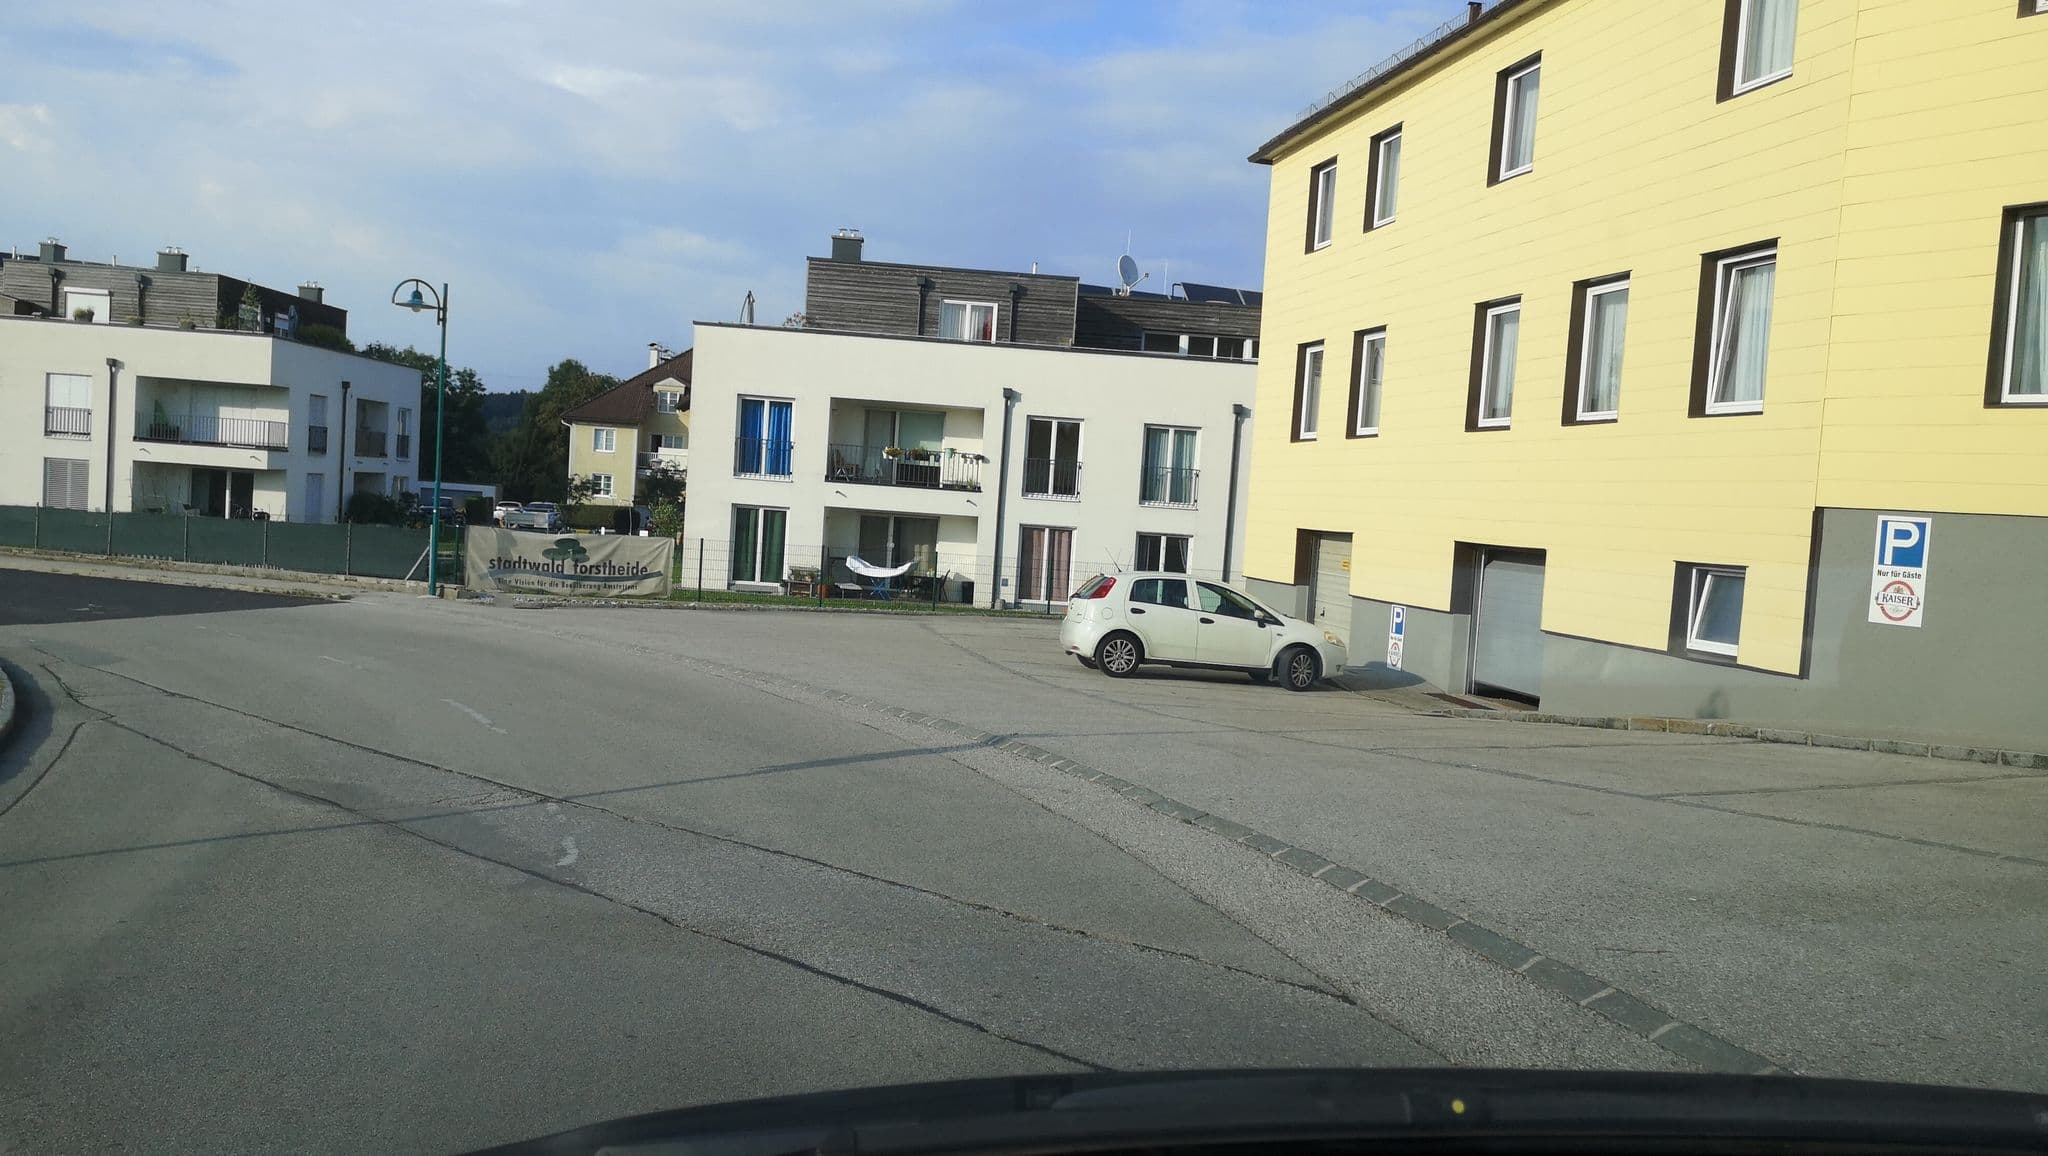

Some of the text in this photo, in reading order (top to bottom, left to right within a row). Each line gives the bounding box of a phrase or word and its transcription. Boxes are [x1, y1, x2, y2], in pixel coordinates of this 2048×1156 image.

[1884, 521, 1920, 565] P
[489, 556, 648, 576] stadtwald forstheide
[1877, 569, 1922, 580] Nur für Gäste
[514, 578, 535, 586] Vision
[537, 579, 547, 587] für
[549, 580, 559, 588] die
[1882, 593, 1914, 606] KAISER
[1393, 607, 1403, 634] P
